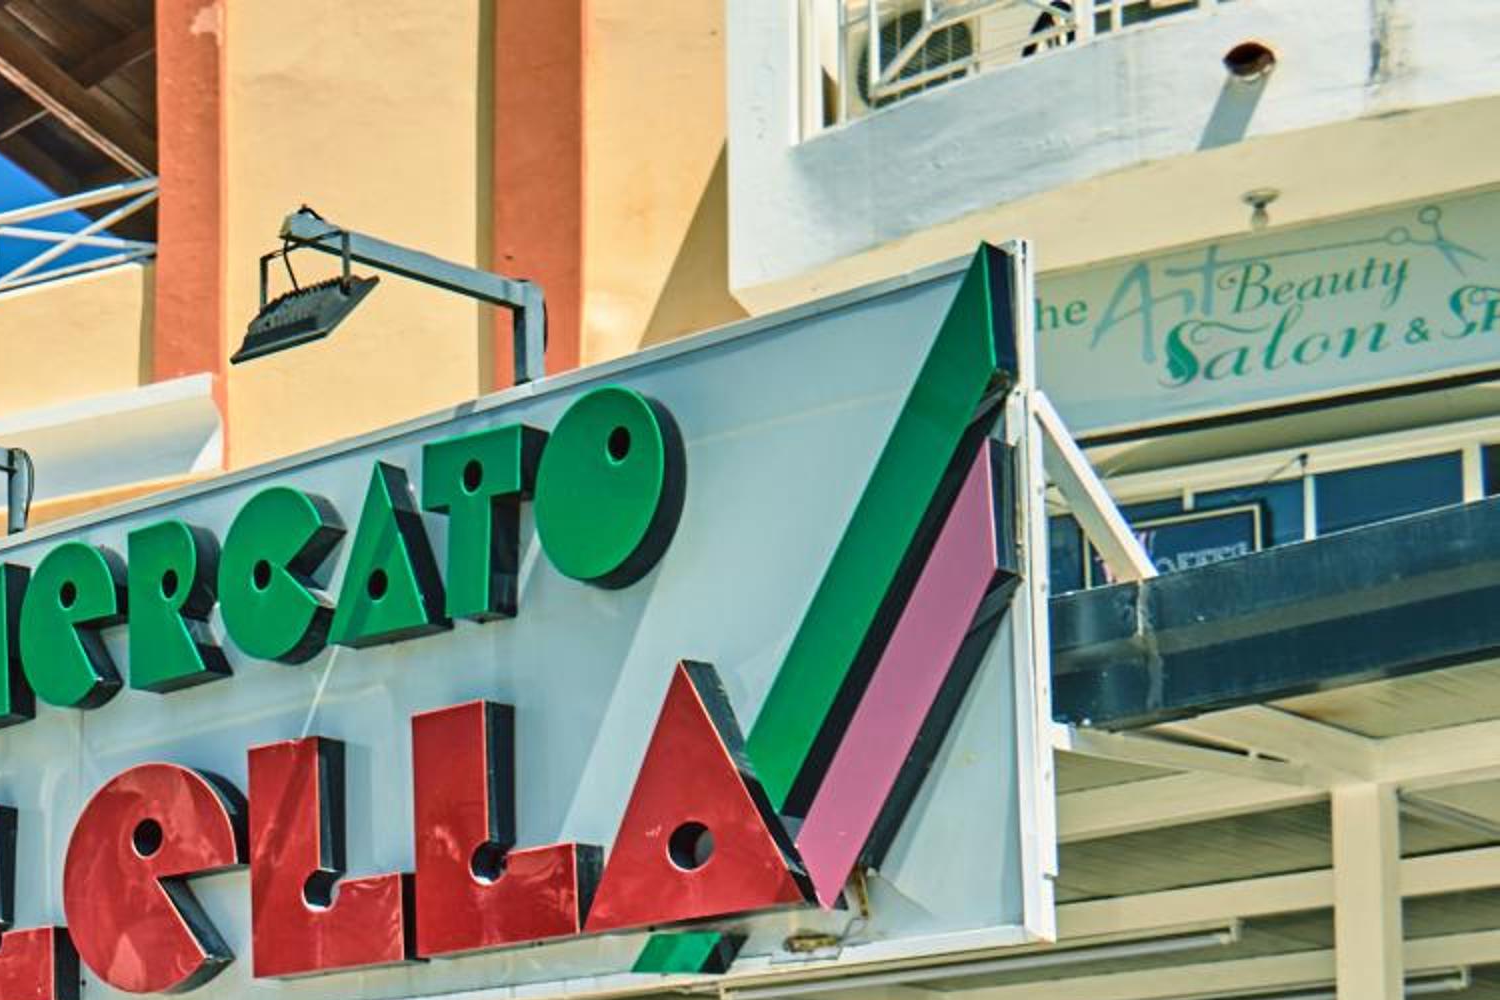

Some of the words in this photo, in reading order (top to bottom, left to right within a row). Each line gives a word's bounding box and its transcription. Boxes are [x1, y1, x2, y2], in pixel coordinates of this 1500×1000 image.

[1034, 298, 1088, 331] he
[1217, 256, 1410, 314] Beauty
[1157, 305, 1393, 387] Salon
[1405, 317, 1429, 345] &
